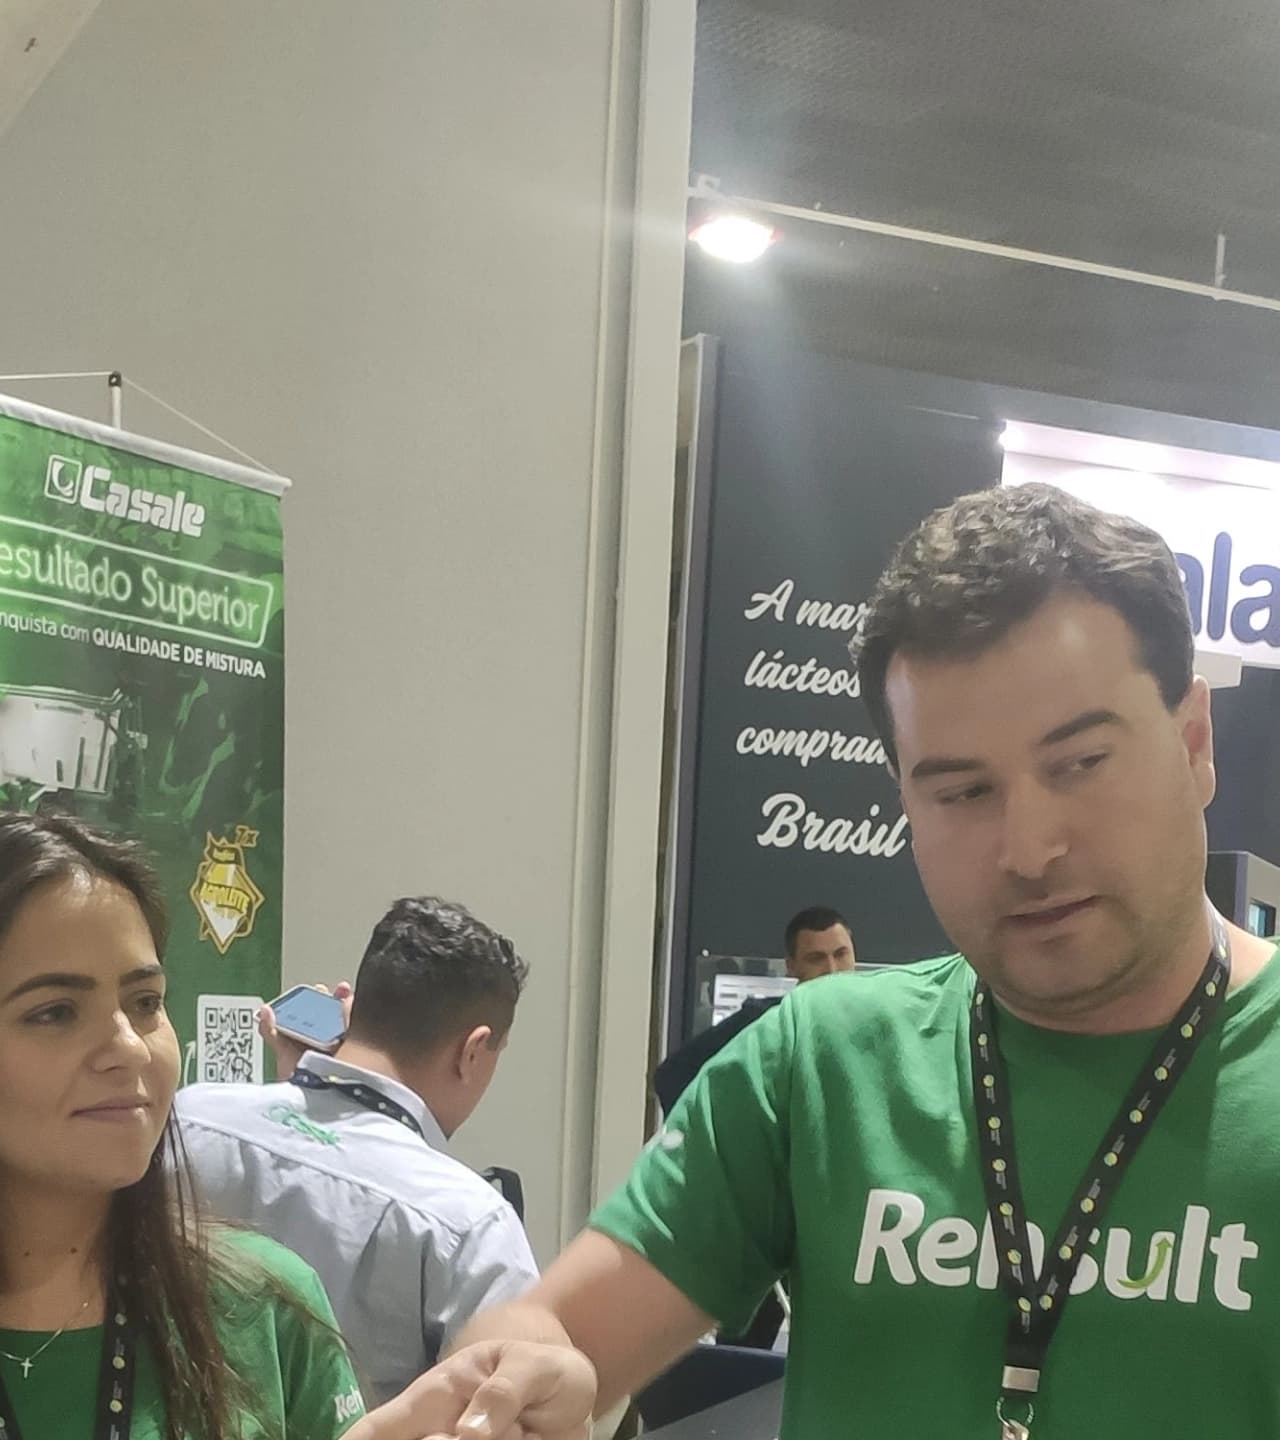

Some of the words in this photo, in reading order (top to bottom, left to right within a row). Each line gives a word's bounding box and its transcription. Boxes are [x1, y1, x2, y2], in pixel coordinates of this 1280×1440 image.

[80, 464, 205, 538] Casale
[141, 566, 259, 632] Superior
[744, 579, 794, 622] A
[60, 623, 90, 643] com
[92, 627, 181, 662] QUALIDADE
[183, 645, 203, 667] DE
[205, 649, 267, 679] MISTURA
[756, 792, 909, 858] Brasil
